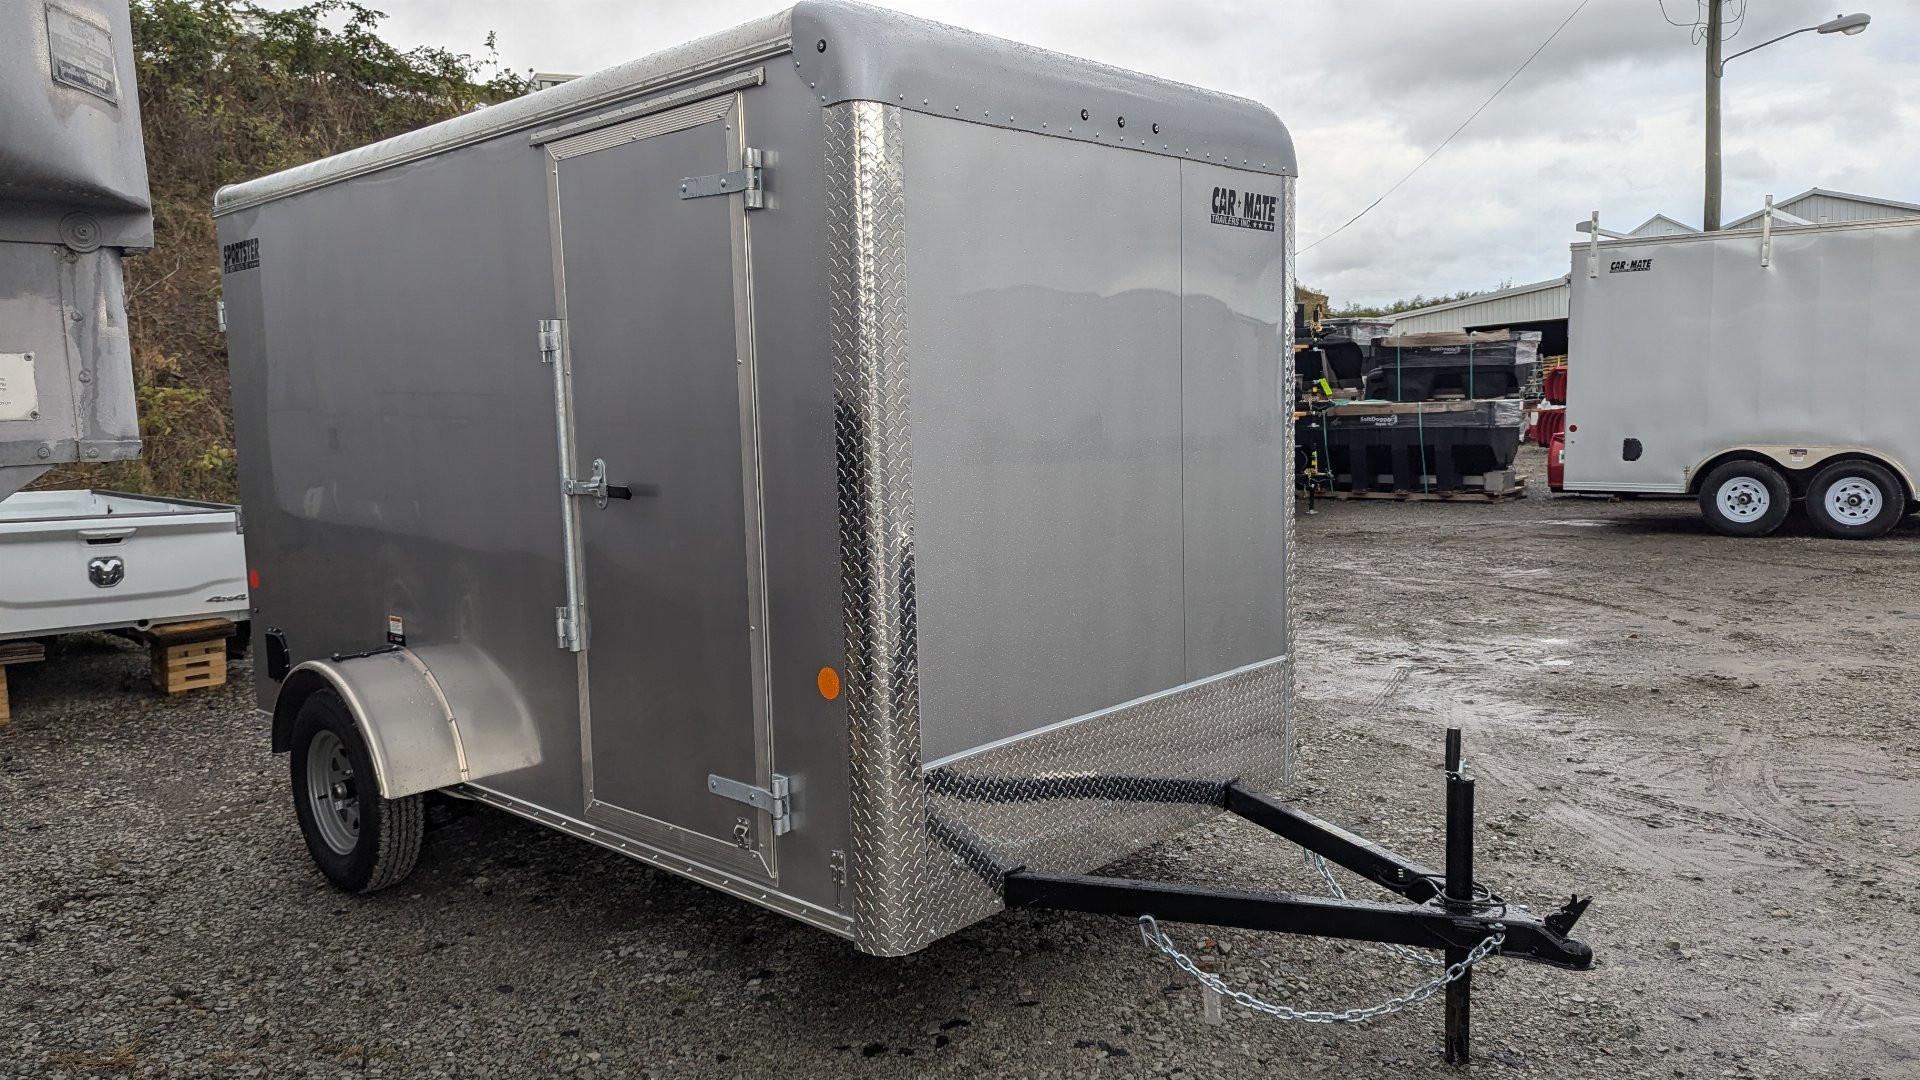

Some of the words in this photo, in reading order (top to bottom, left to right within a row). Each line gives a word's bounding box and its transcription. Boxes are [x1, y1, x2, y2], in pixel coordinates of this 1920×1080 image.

[1211, 186, 1236, 216] CAR
[1243, 191, 1277, 222] MATE
[1211, 214, 1240, 227] TRAILERS
[223, 237, 259, 267] SPORTSTER
